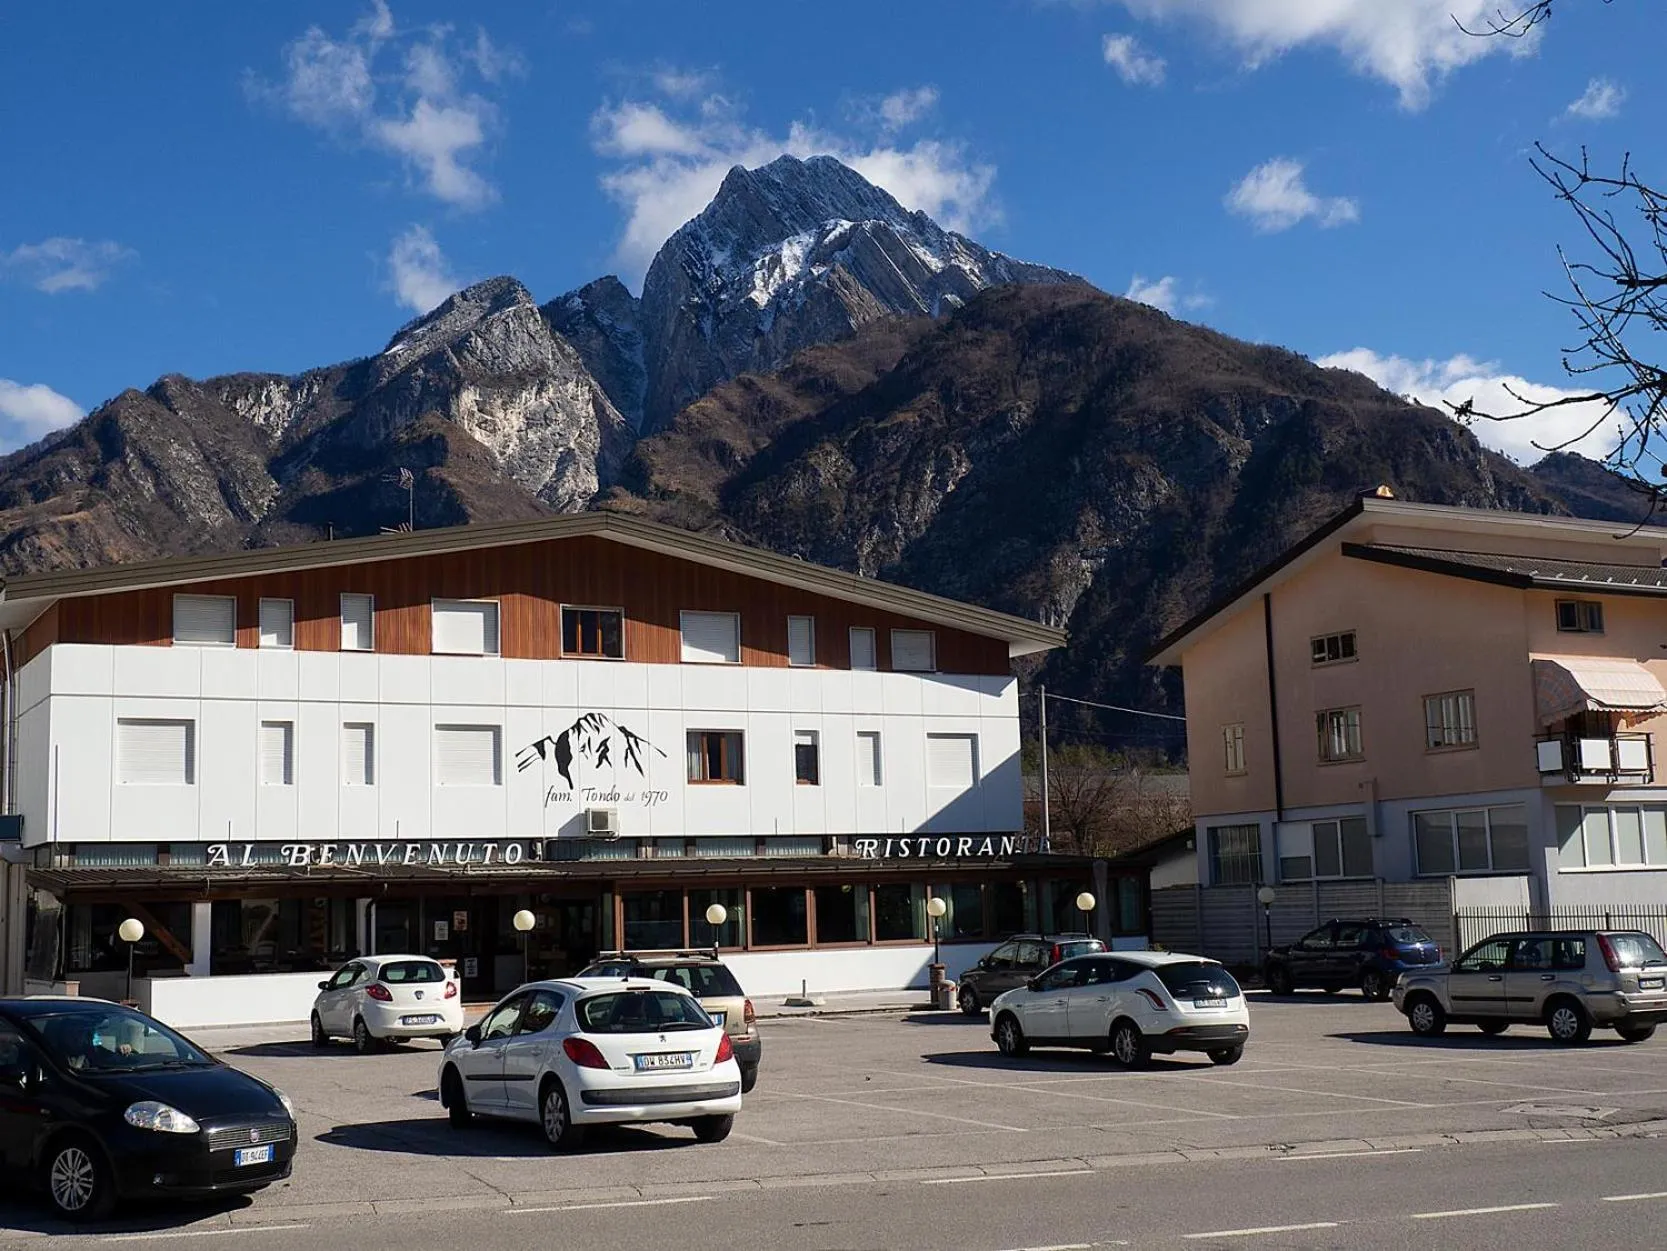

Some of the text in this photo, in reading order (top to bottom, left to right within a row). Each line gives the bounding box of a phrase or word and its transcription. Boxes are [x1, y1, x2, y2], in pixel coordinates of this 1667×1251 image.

[544, 785, 573, 808] fam.
[582, 784, 621, 802] Tondo
[641, 790, 668, 807] 1970
[207, 842, 523, 867] AL BENVENUTO
